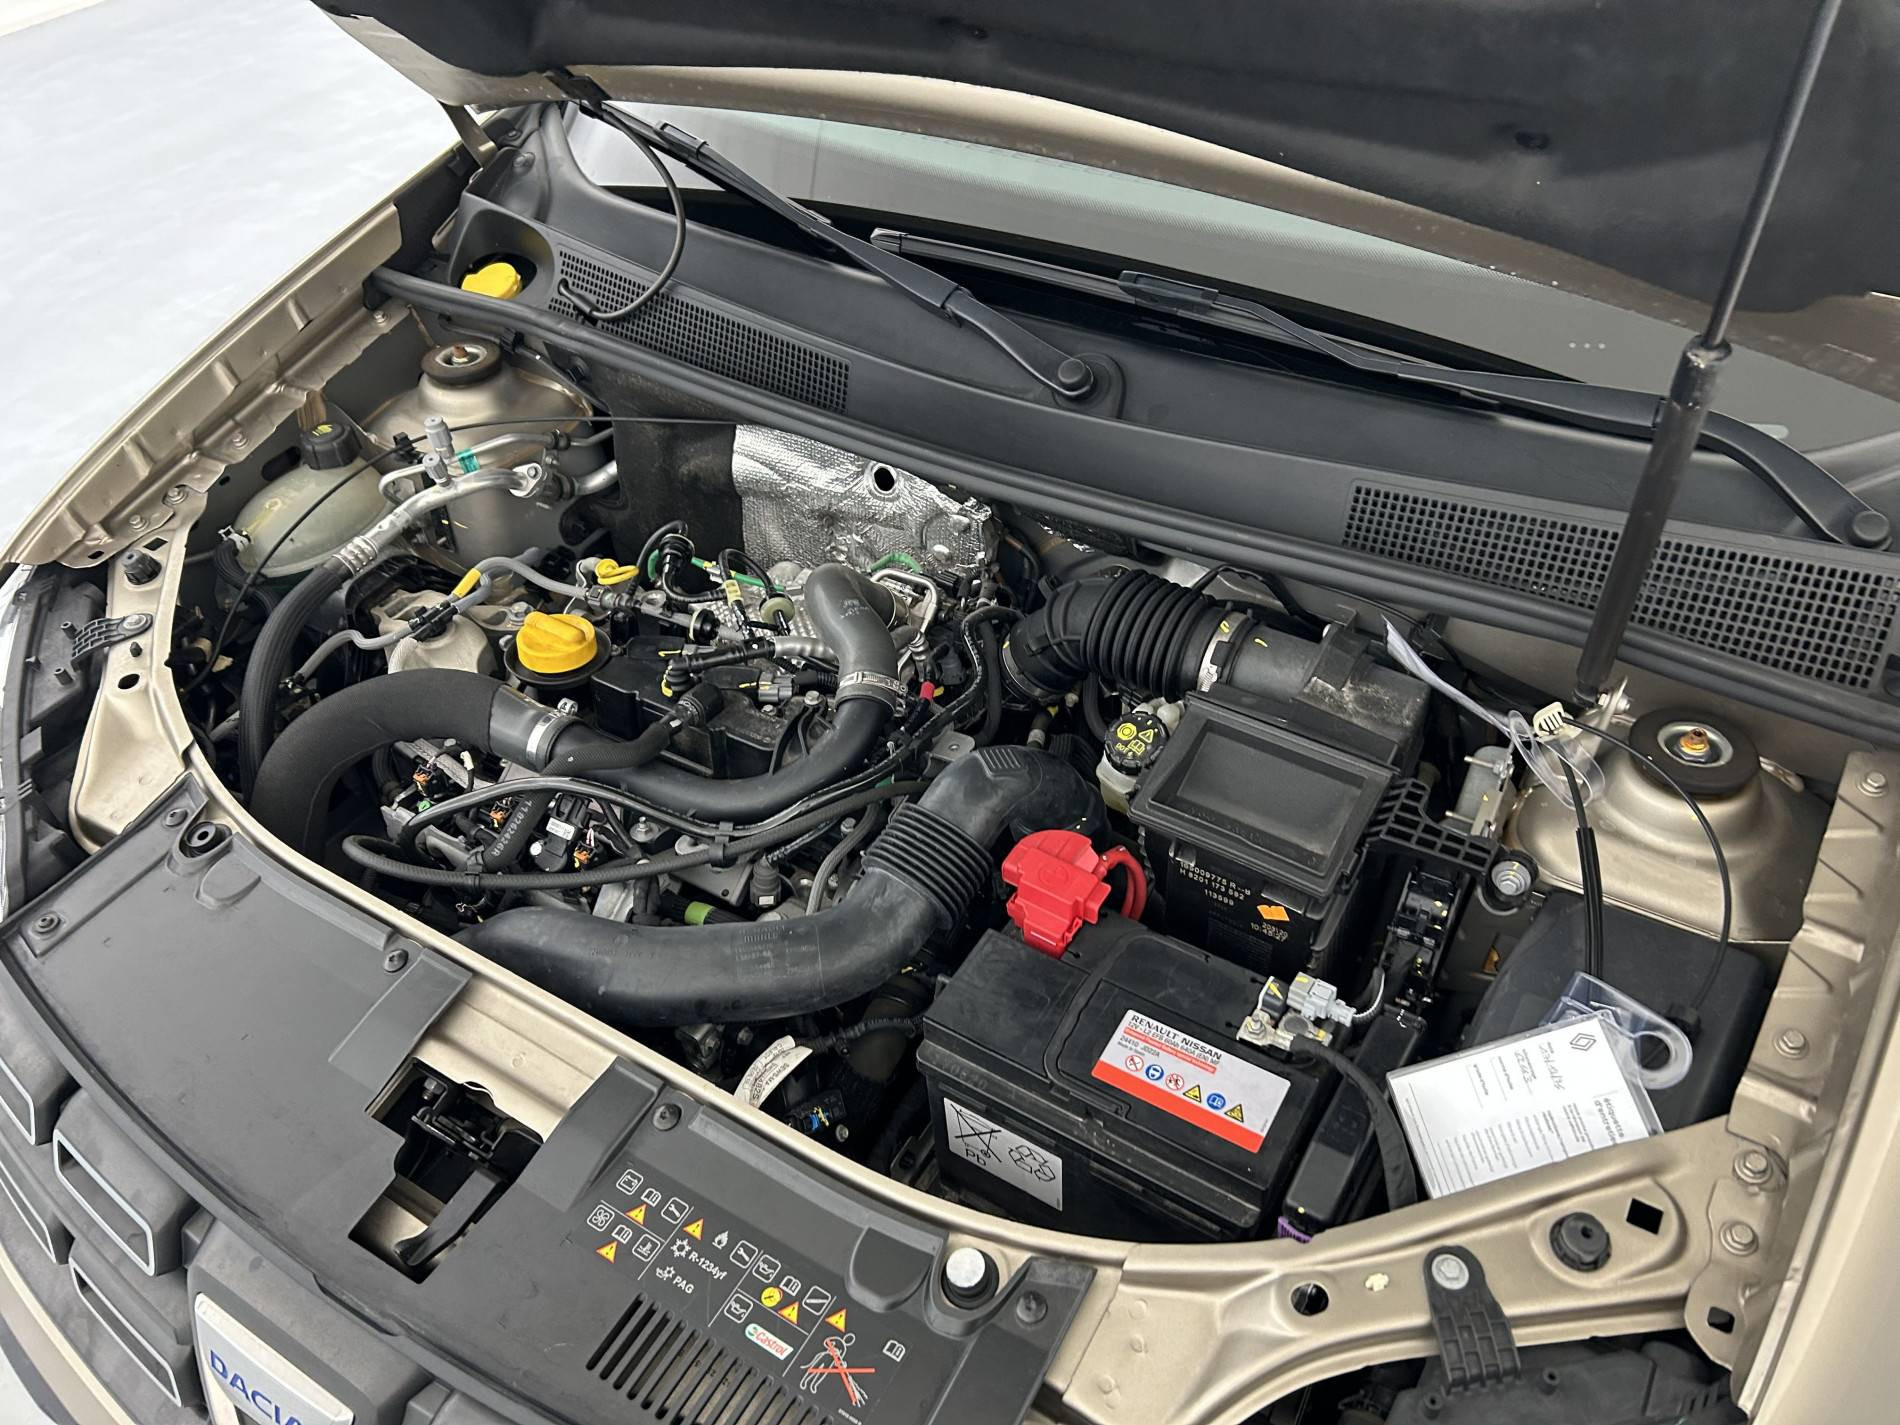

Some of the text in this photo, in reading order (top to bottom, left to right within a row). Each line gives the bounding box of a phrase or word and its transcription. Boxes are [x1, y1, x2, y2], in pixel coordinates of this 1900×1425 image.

[1115, 742, 1130, 753] DOT
[1131, 1015, 1178, 1040] RENAULT
[1181, 1037, 1222, 1060] NISSAN
[965, 1148, 987, 1166] Pb
[688, 1251, 728, 1280] R-1234yf
[673, 1275, 695, 1294] PAG
[755, 1331, 788, 1356] Castrol
